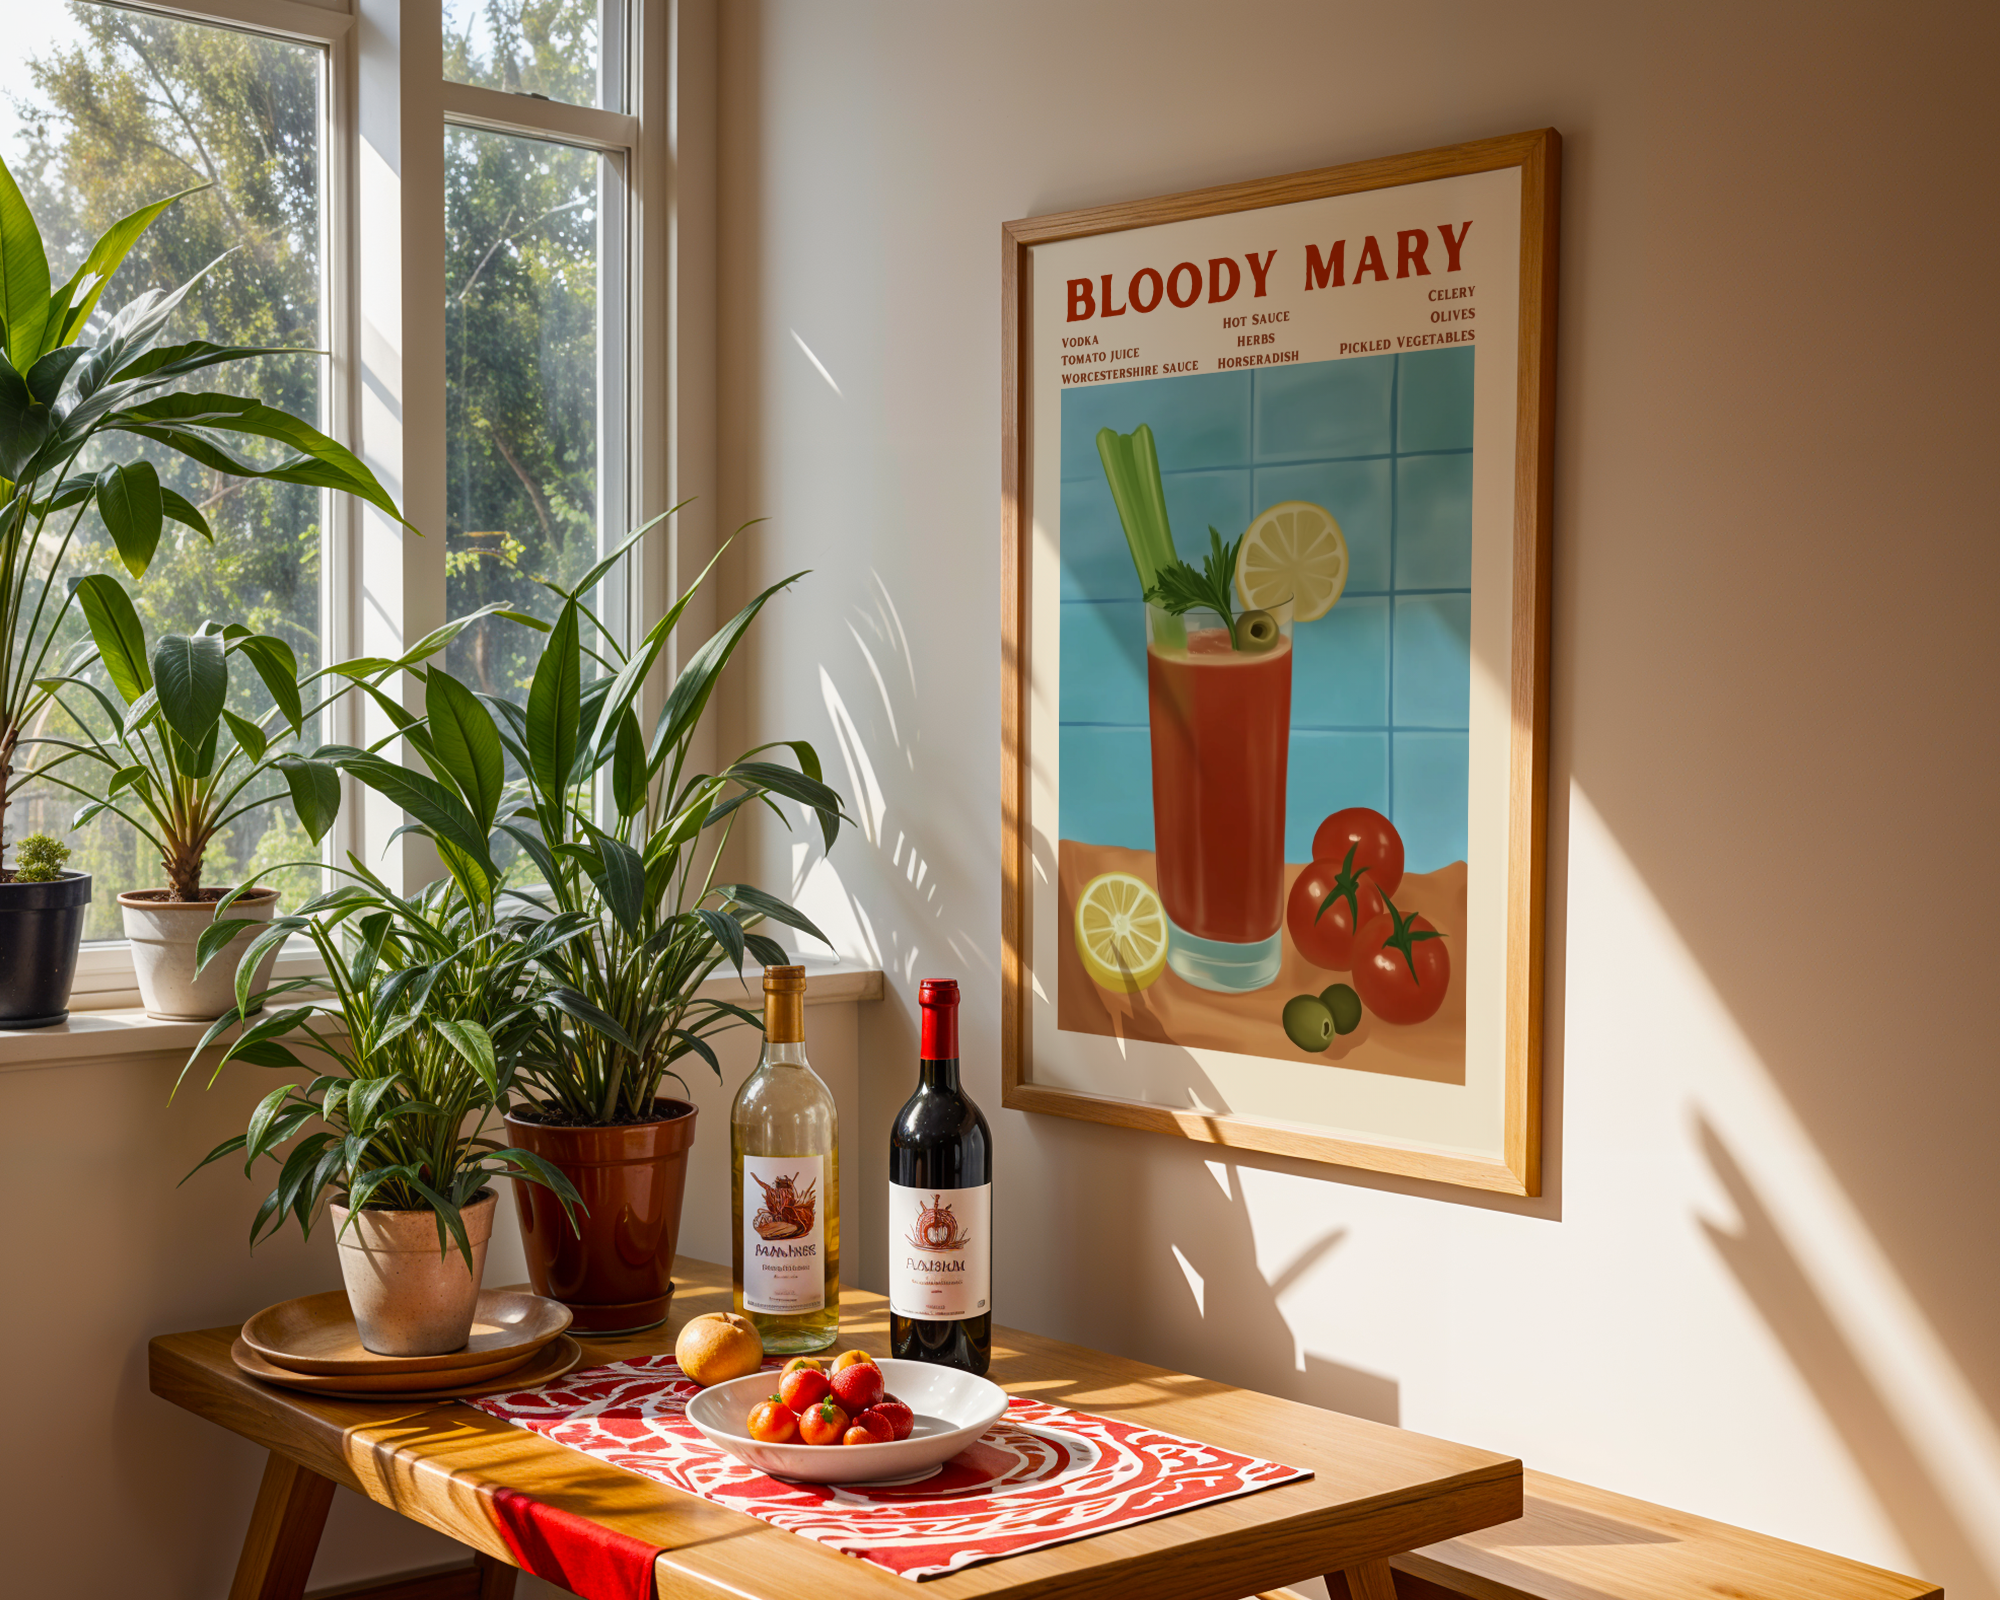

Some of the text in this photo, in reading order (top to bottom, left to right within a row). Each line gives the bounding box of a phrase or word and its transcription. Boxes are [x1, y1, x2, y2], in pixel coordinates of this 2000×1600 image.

[1066, 220, 1474, 323] BLOODY MARY
[1428, 285, 1476, 302] CELERY
[1222, 311, 1290, 329] HOT SAUCE
[1430, 308, 1476, 323] OLIVES
[1061, 335, 1099, 349] VODKA
[1237, 333, 1275, 347] HERBS
[1339, 329, 1476, 355] PICKLED VEGETABLES
[1061, 347, 1140, 366] TOMATO JUICE
[1217, 350, 1299, 369] HORSERADISH
[1061, 360, 1199, 385] WORCESTERSHIRE SAUCE
